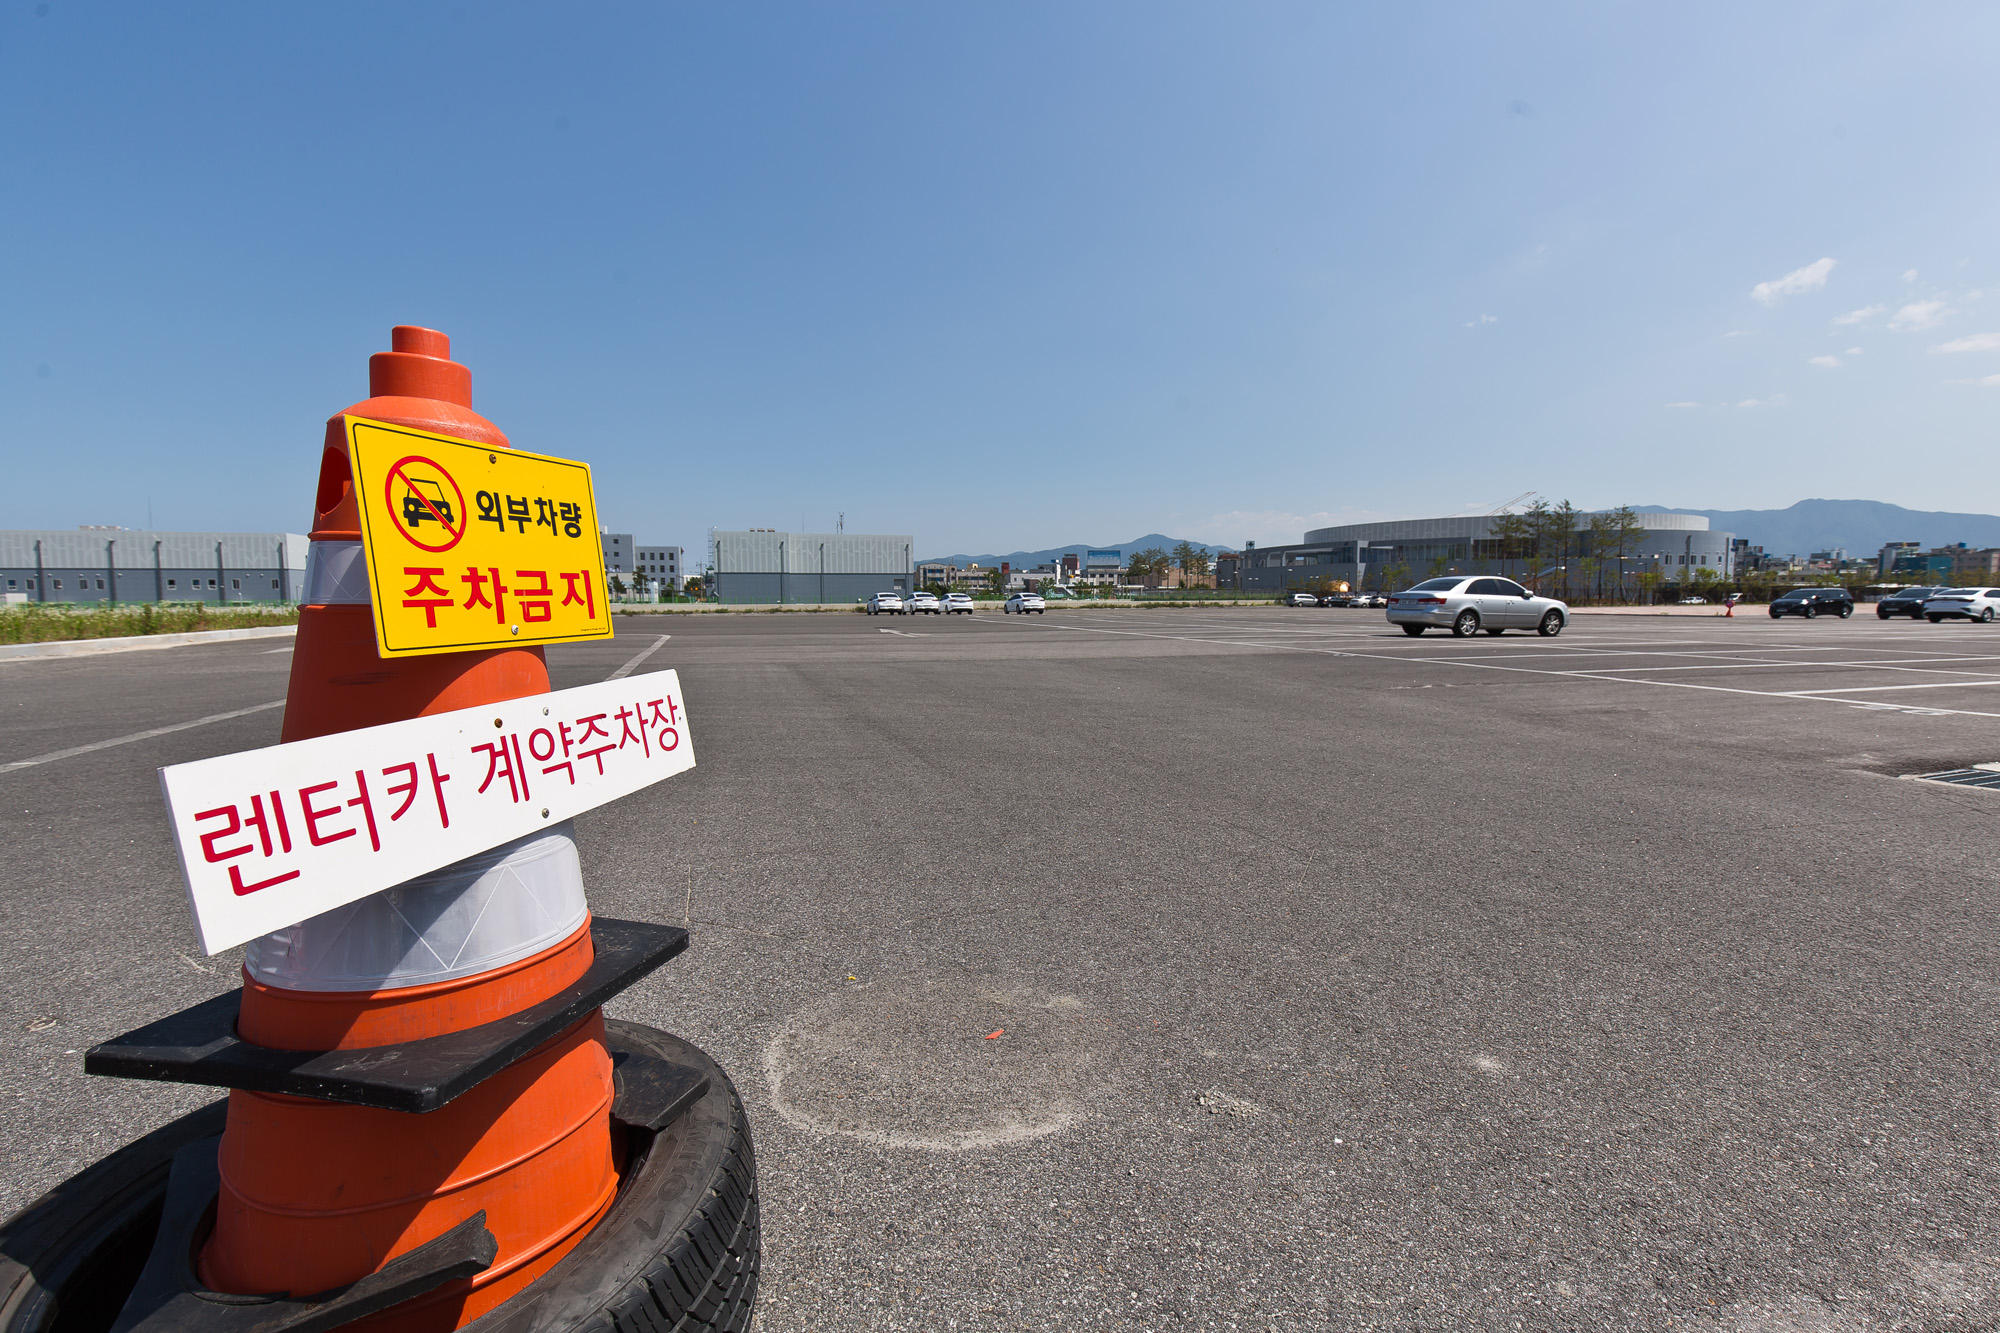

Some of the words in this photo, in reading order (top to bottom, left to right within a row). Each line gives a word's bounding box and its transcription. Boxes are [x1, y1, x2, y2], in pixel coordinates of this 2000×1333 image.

[476, 490, 582, 539] 외부차량
[402, 567, 596, 628] 주차금지
[194, 752, 450, 897] 렌터카
[471, 695, 680, 803] 계약주차장
